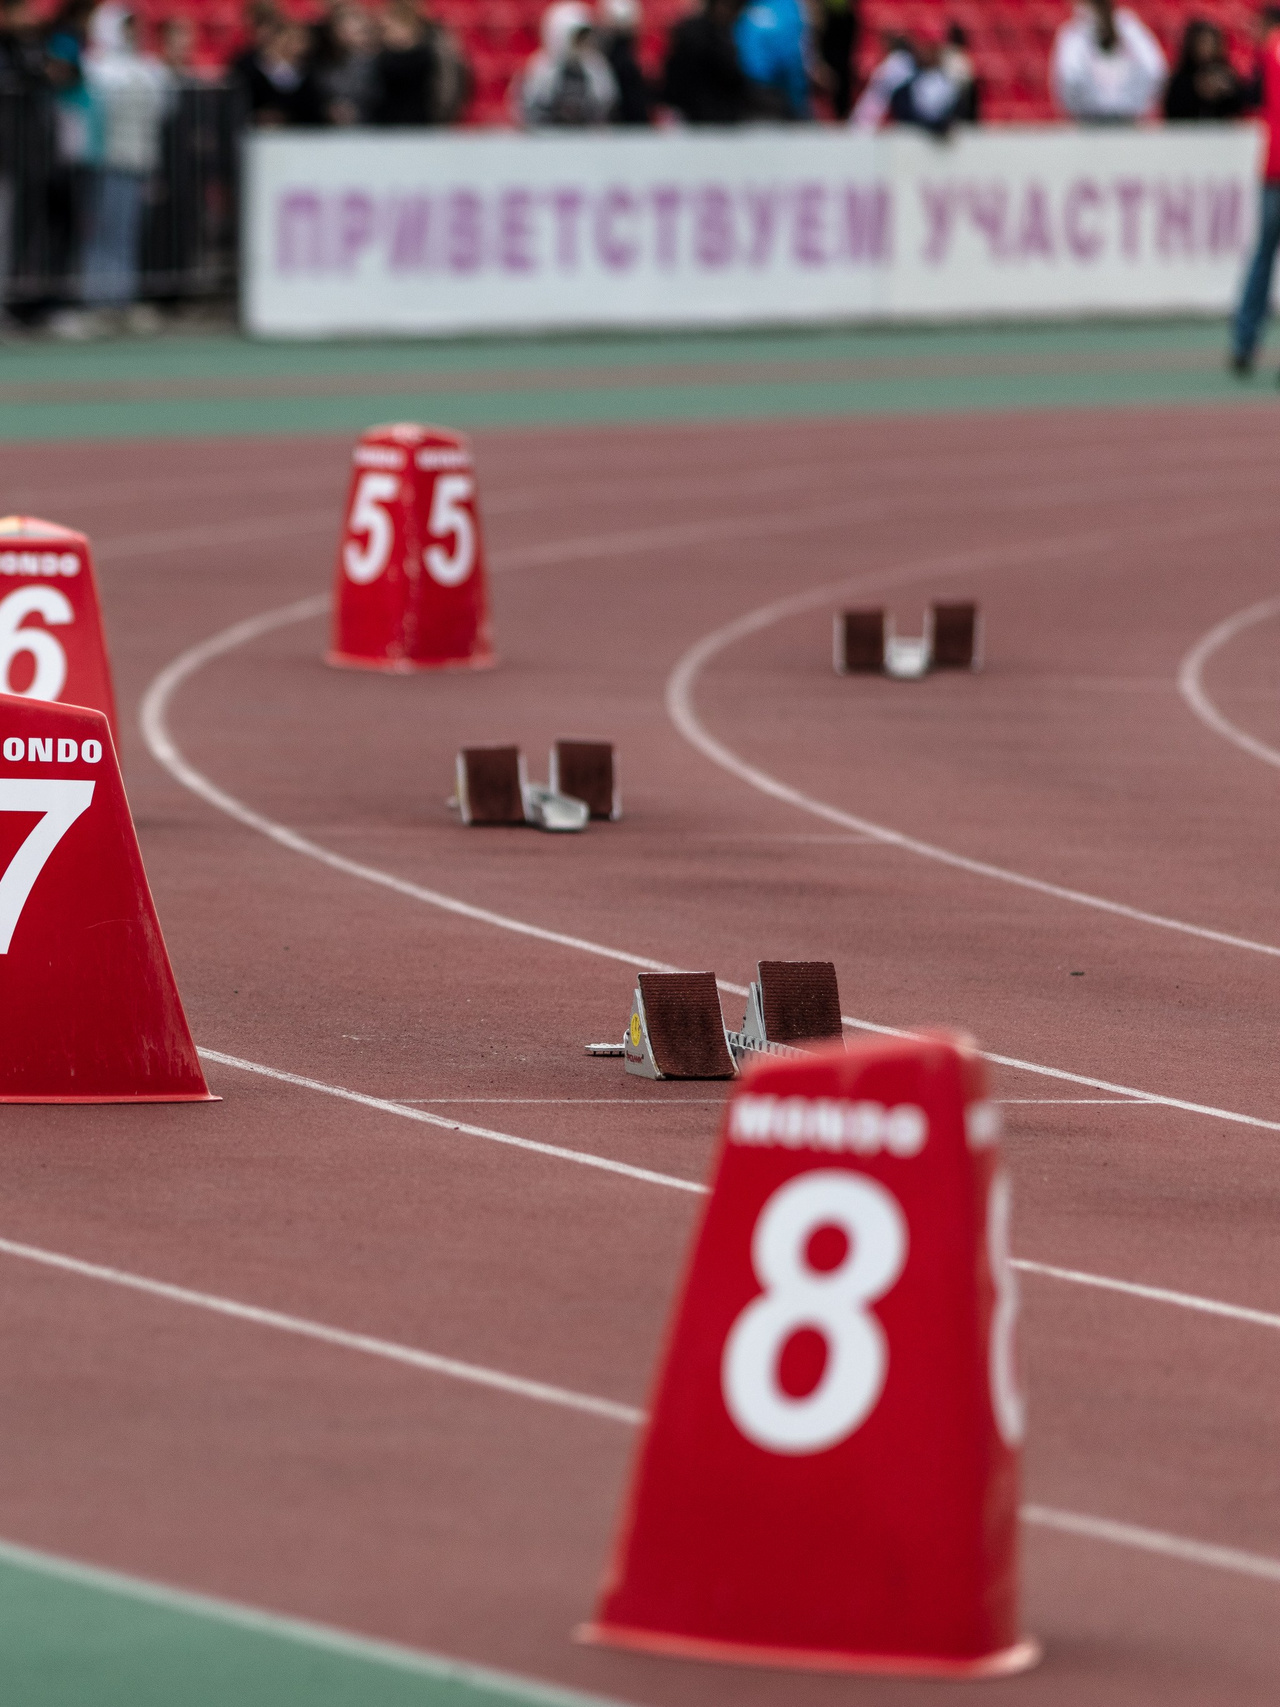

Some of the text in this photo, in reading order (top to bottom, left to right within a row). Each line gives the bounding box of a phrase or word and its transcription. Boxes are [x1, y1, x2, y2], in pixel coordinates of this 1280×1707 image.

[276, 180, 890, 274] ПРИВЕТСТВУЕМ
[342, 470, 400, 585] 5
[423, 472, 477, 588] 5
[729, 1094, 928, 1158] MONDO
[721, 1168, 910, 1454] 8
